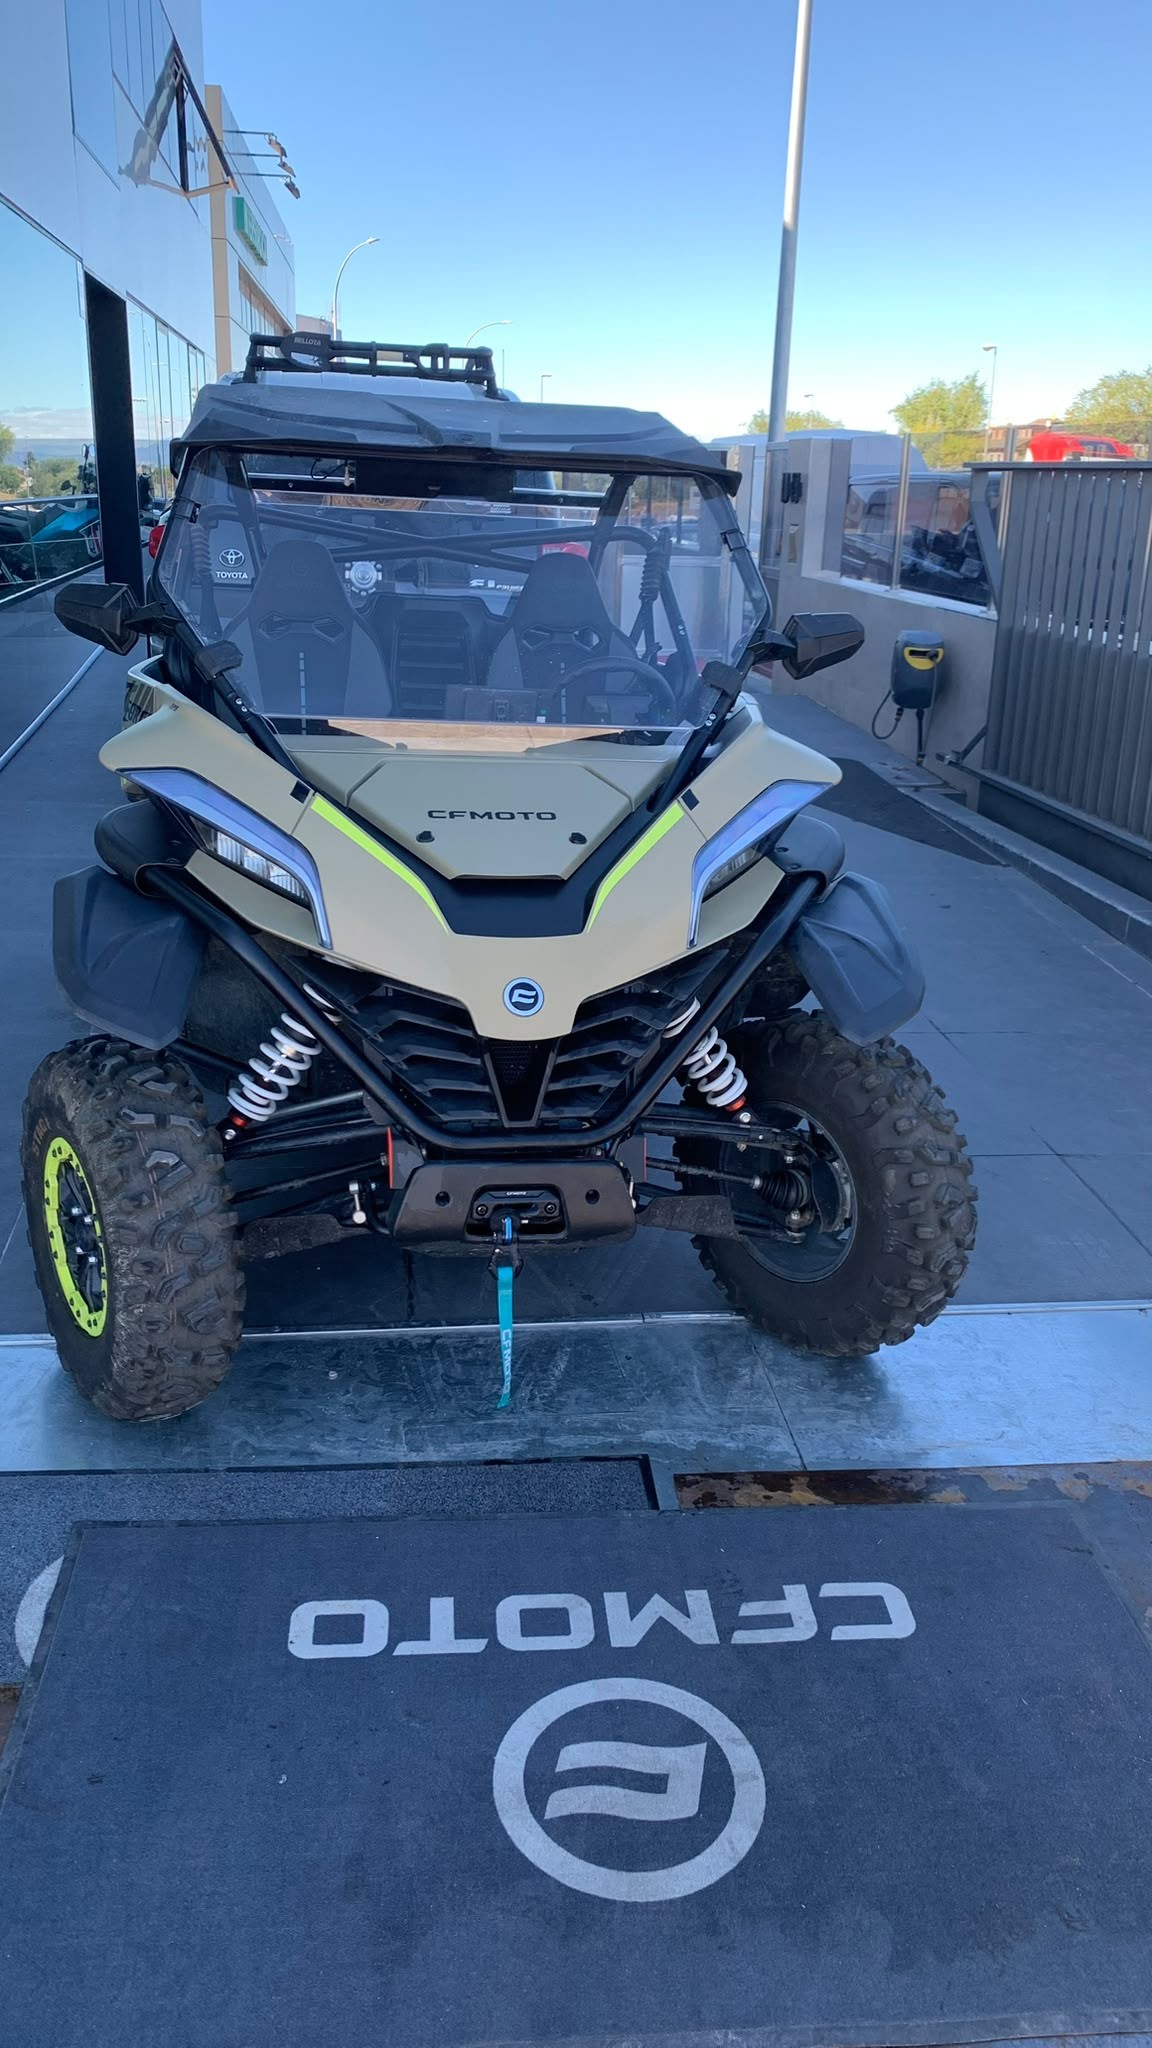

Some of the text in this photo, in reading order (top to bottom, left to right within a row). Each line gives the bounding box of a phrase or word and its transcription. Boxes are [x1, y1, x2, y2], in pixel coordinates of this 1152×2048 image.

[216, 571, 248, 579] TOYOTA
[427, 810, 557, 821] CFMOTO
[288, 1582, 916, 1659] CFMOTO
